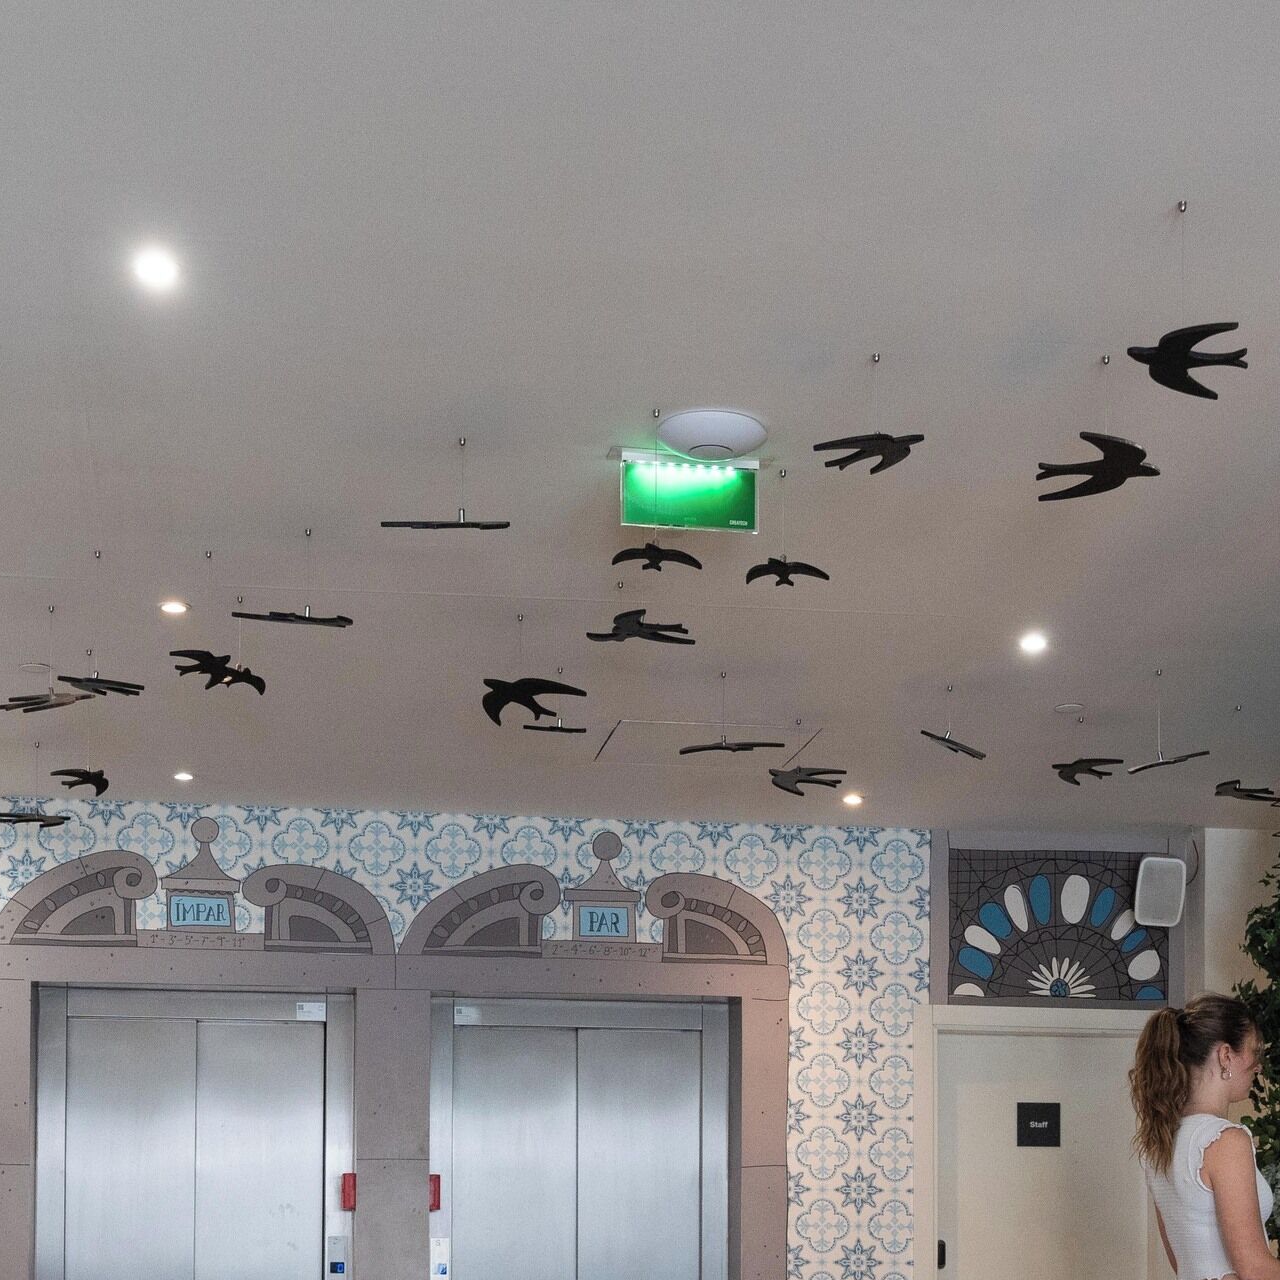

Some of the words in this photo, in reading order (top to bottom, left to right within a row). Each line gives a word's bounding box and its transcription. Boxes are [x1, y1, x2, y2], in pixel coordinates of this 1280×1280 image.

[174, 898, 227, 922] ÍMPAR
[588, 911, 620, 933] PAR
[1029, 1120, 1049, 1129] Staff
